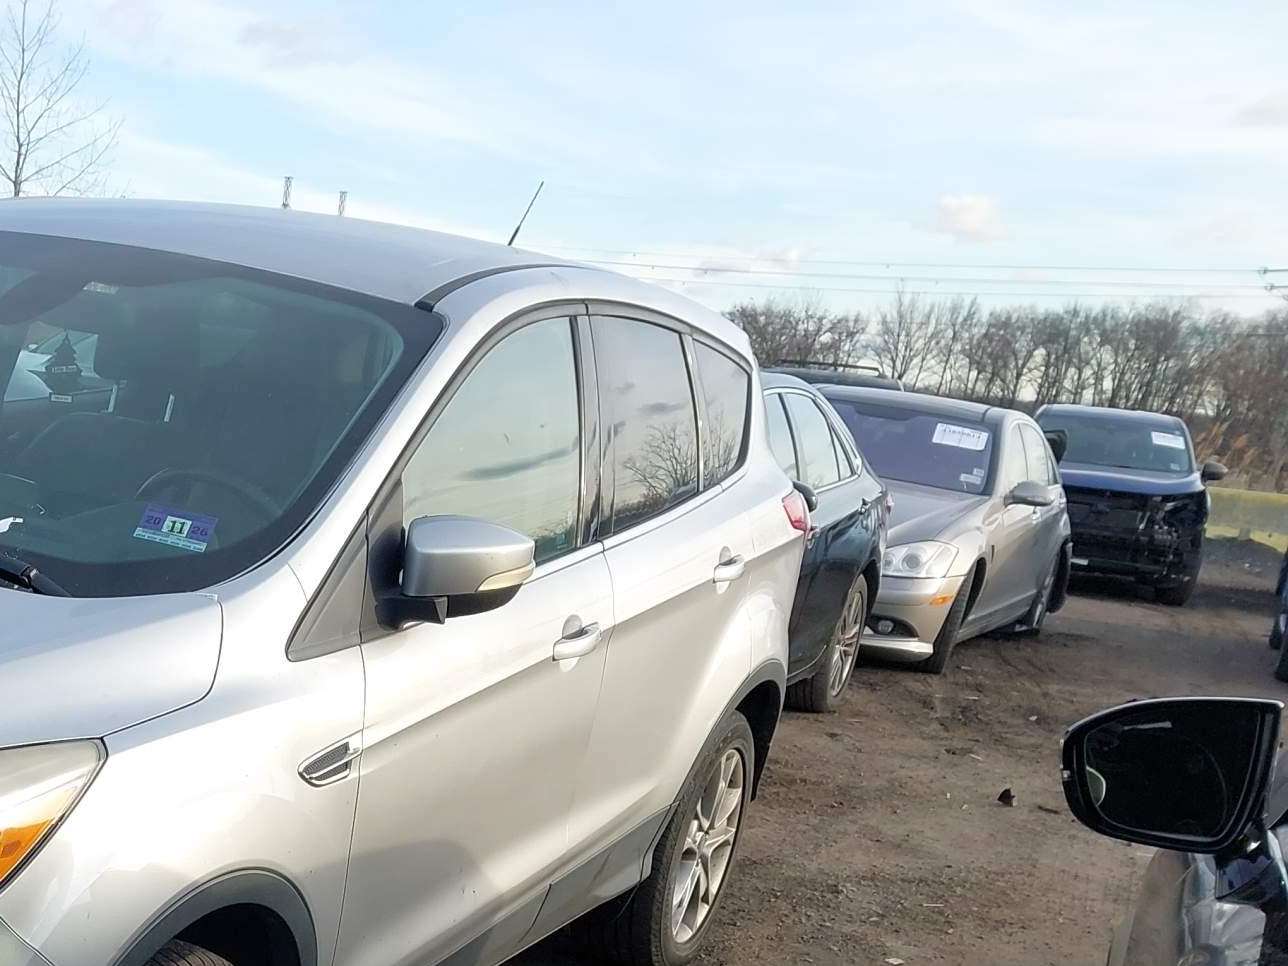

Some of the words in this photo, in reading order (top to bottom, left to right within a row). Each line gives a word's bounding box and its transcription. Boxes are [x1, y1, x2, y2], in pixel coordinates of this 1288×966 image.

[145, 515, 162, 526] 20
[167, 519, 186, 535] 11
[191, 526, 208, 537] 26
